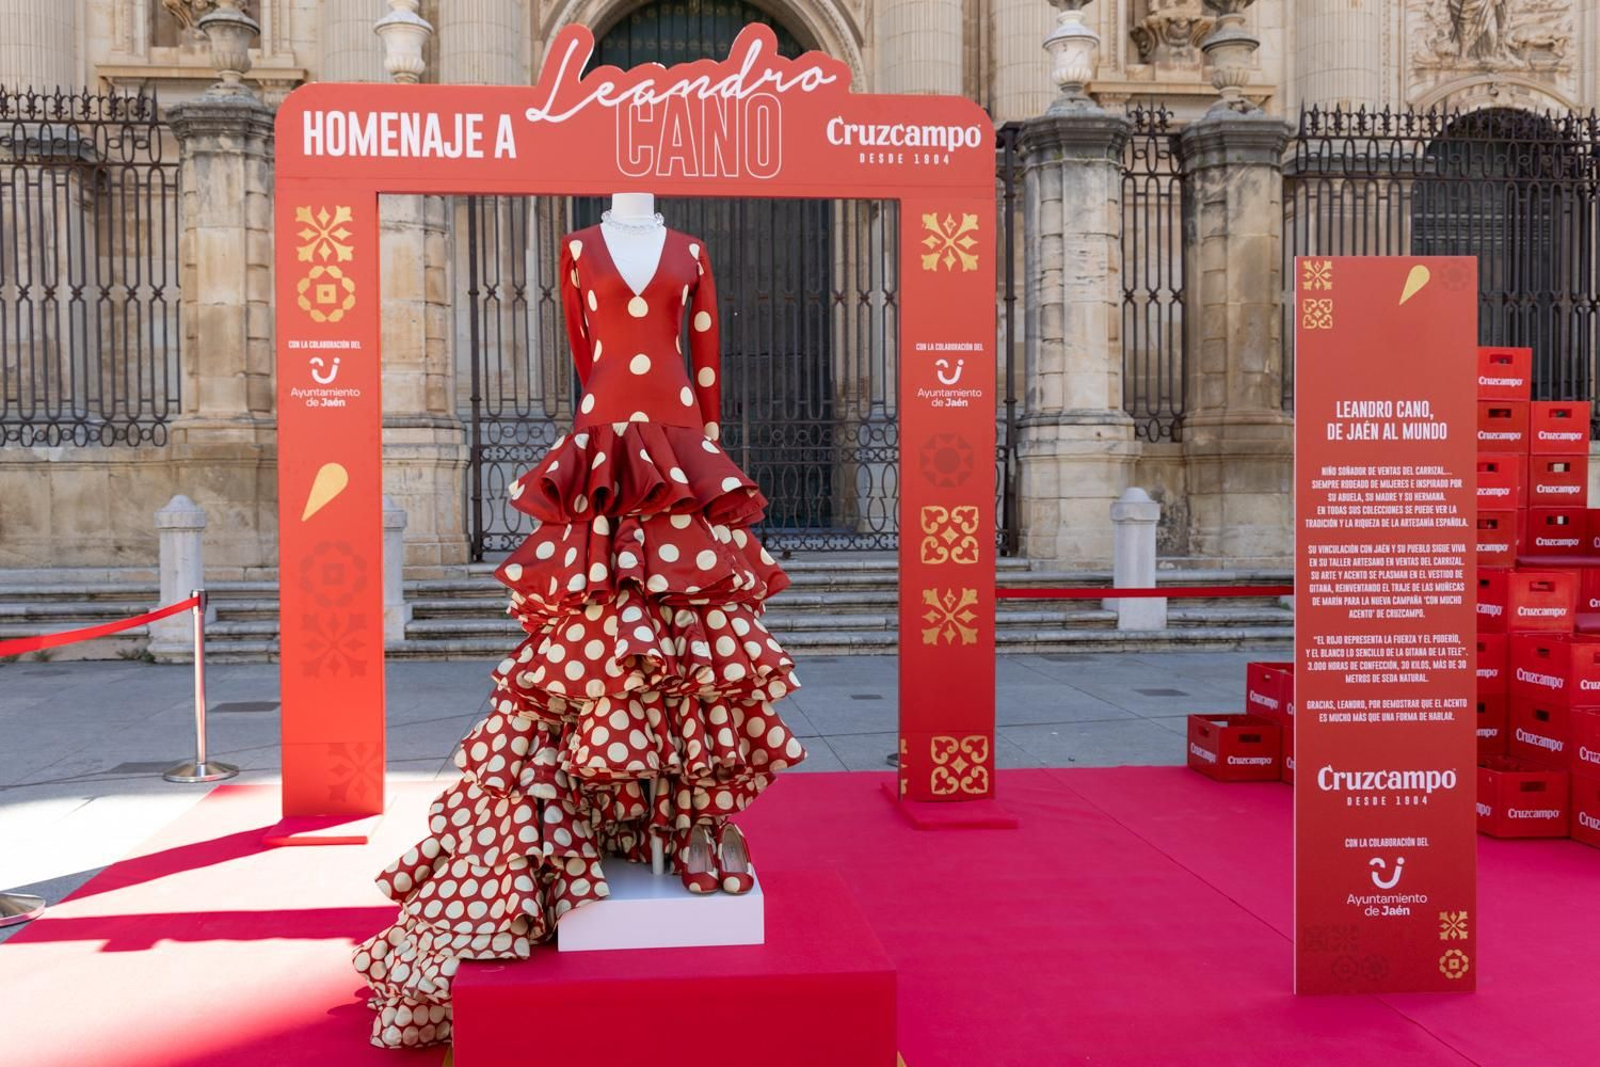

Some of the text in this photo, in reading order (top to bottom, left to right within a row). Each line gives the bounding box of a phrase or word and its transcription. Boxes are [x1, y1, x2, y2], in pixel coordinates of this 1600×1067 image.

[525, 38, 837, 122] Leandro
[303, 110, 517, 160] HOMENAJE A
[616, 91, 782, 179] CANO
[826, 115, 982, 152] Cruzcampo
[860, 152, 950, 164] DESDE 1904
[1478, 376, 1523, 386] Cruzcampo
[290, 387, 361, 398] Ayuntamiento
[917, 388, 982, 398] Ayuntamiento
[306, 398, 346, 407] de Jaén
[932, 398, 968, 407] de Jaén
[1336, 400, 1434, 420] LEANDRO CANO,
[1327, 420, 1447, 440] DE JAÉN AL MUNDO
[1477, 430, 1522, 441] Cruzcampo
[1538, 430, 1582, 441] Cruzcampo
[1368, 466, 1414, 476] DE VENTAS DEL
[1312, 478, 1462, 489] SIEMPRE RODEADO DE MUJERES INSPIRADO POR
[1536, 484, 1580, 494] Cruzcampo
[1328, 492, 1337, 502] SU
[1365, 492, 1374, 502] SU
[1375, 492, 1397, 502] MADRE
[1404, 492, 1413, 502] SU
[1476, 488, 1510, 498] zcampo
[1317, 505, 1457, 515] EN TODAS SUS COLECCIONES SE PUEDE VER LA
[1305, 518, 1338, 528] TRADICIÓN
[1344, 518, 1354, 528] LA
[1354, 518, 1380, 529] RIQUEZA
[1381, 518, 1390, 528] DE
[1391, 518, 1400, 528] LA
[1400, 517, 1434, 527] ARTESANÍA
[1476, 544, 1508, 553] zcampo
[1536, 538, 1580, 548] Cruzcampo
[1308, 544, 1466, 554] SU VINCULACIÓN CON JAÉN SU PUEBLO SIGUE VIVA
[1309, 558, 1318, 567] EN
[1318, 558, 1328, 567] SU
[1329, 558, 1352, 567] TALLER
[1352, 557, 1385, 567] ARTESANO
[1386, 557, 1394, 566] EN
[1395, 556, 1420, 566] VENTAS
[1420, 556, 1432, 566] DEL
[1310, 569, 1463, 580] SU ARTE ACENTO SE PLASMAN EN EL VESTIDO DE
[1335, 583, 1381, 593] REINVENTANDO
[1382, 583, 1390, 592] EL
[1391, 582, 1411, 592] TRAJE
[1412, 582, 1420, 592] DE
[1421, 582, 1434, 592] LAS
[1434, 581, 1465, 592] MUÑECAS
[1312, 596, 1320, 606] DE
[1344, 596, 1360, 606] PARA
[1361, 596, 1370, 606] LA
[1370, 596, 1392, 606] NUEVA
[1392, 594, 1422, 605] CAMPAÑA
[1439, 595, 1462, 604] MUCHO
[1376, 609, 1384, 618] DE
[1476, 603, 1502, 617] campo
[1518, 606, 1567, 617] Cruzcampo
[1326, 635, 1343, 645] ROJO
[1344, 635, 1383, 645] REPRESENTA
[1384, 635, 1392, 644] LA
[1393, 634, 1417, 644] FUERZA
[1423, 634, 1431, 644] EL
[1311, 647, 1446, 658] EL BLANCO LO SENCILLO DE LA GITANA DE LA
[1328, 661, 1349, 670] HORAS
[1350, 661, 1358, 670] DE
[1400, 660, 1410, 670] 30
[1432, 659, 1447, 669] MÁS
[1448, 660, 1456, 669] DE
[1457, 660, 1467, 669] 30
[1345, 674, 1371, 683] METROS
[1372, 674, 1380, 683] DE
[1381, 673, 1398, 683] SEDA
[1516, 668, 1564, 690] Cruzcampo
[1368, 700, 1381, 709] POR
[1382, 699, 1420, 709] DEMOSTRAR
[1421, 699, 1433, 709] QUE
[1434, 699, 1442, 708] EL
[1443, 698, 1468, 708] ACENTO
[1319, 713, 1328, 723] ES
[1328, 712, 1352, 722] MUCHO
[1352, 712, 1367, 722] MÁS
[1368, 712, 1380, 723] QUE
[1381, 712, 1395, 722] UNA
[1396, 712, 1418, 722] FORMA
[1419, 712, 1427, 721] DE
[1516, 728, 1564, 752] Cruzcampo
[1227, 756, 1272, 766] Cruzcampo
[1318, 764, 1457, 793] Cruzcampo
[1346, 795, 1428, 806] DESDE 1904
[1508, 808, 1560, 819] Cruzcampo
[1345, 836, 1429, 848] CON LA COLABORACIÓN DEL
[1346, 892, 1428, 906] Ayuntamiento
[1364, 904, 1410, 917] de Jaén
